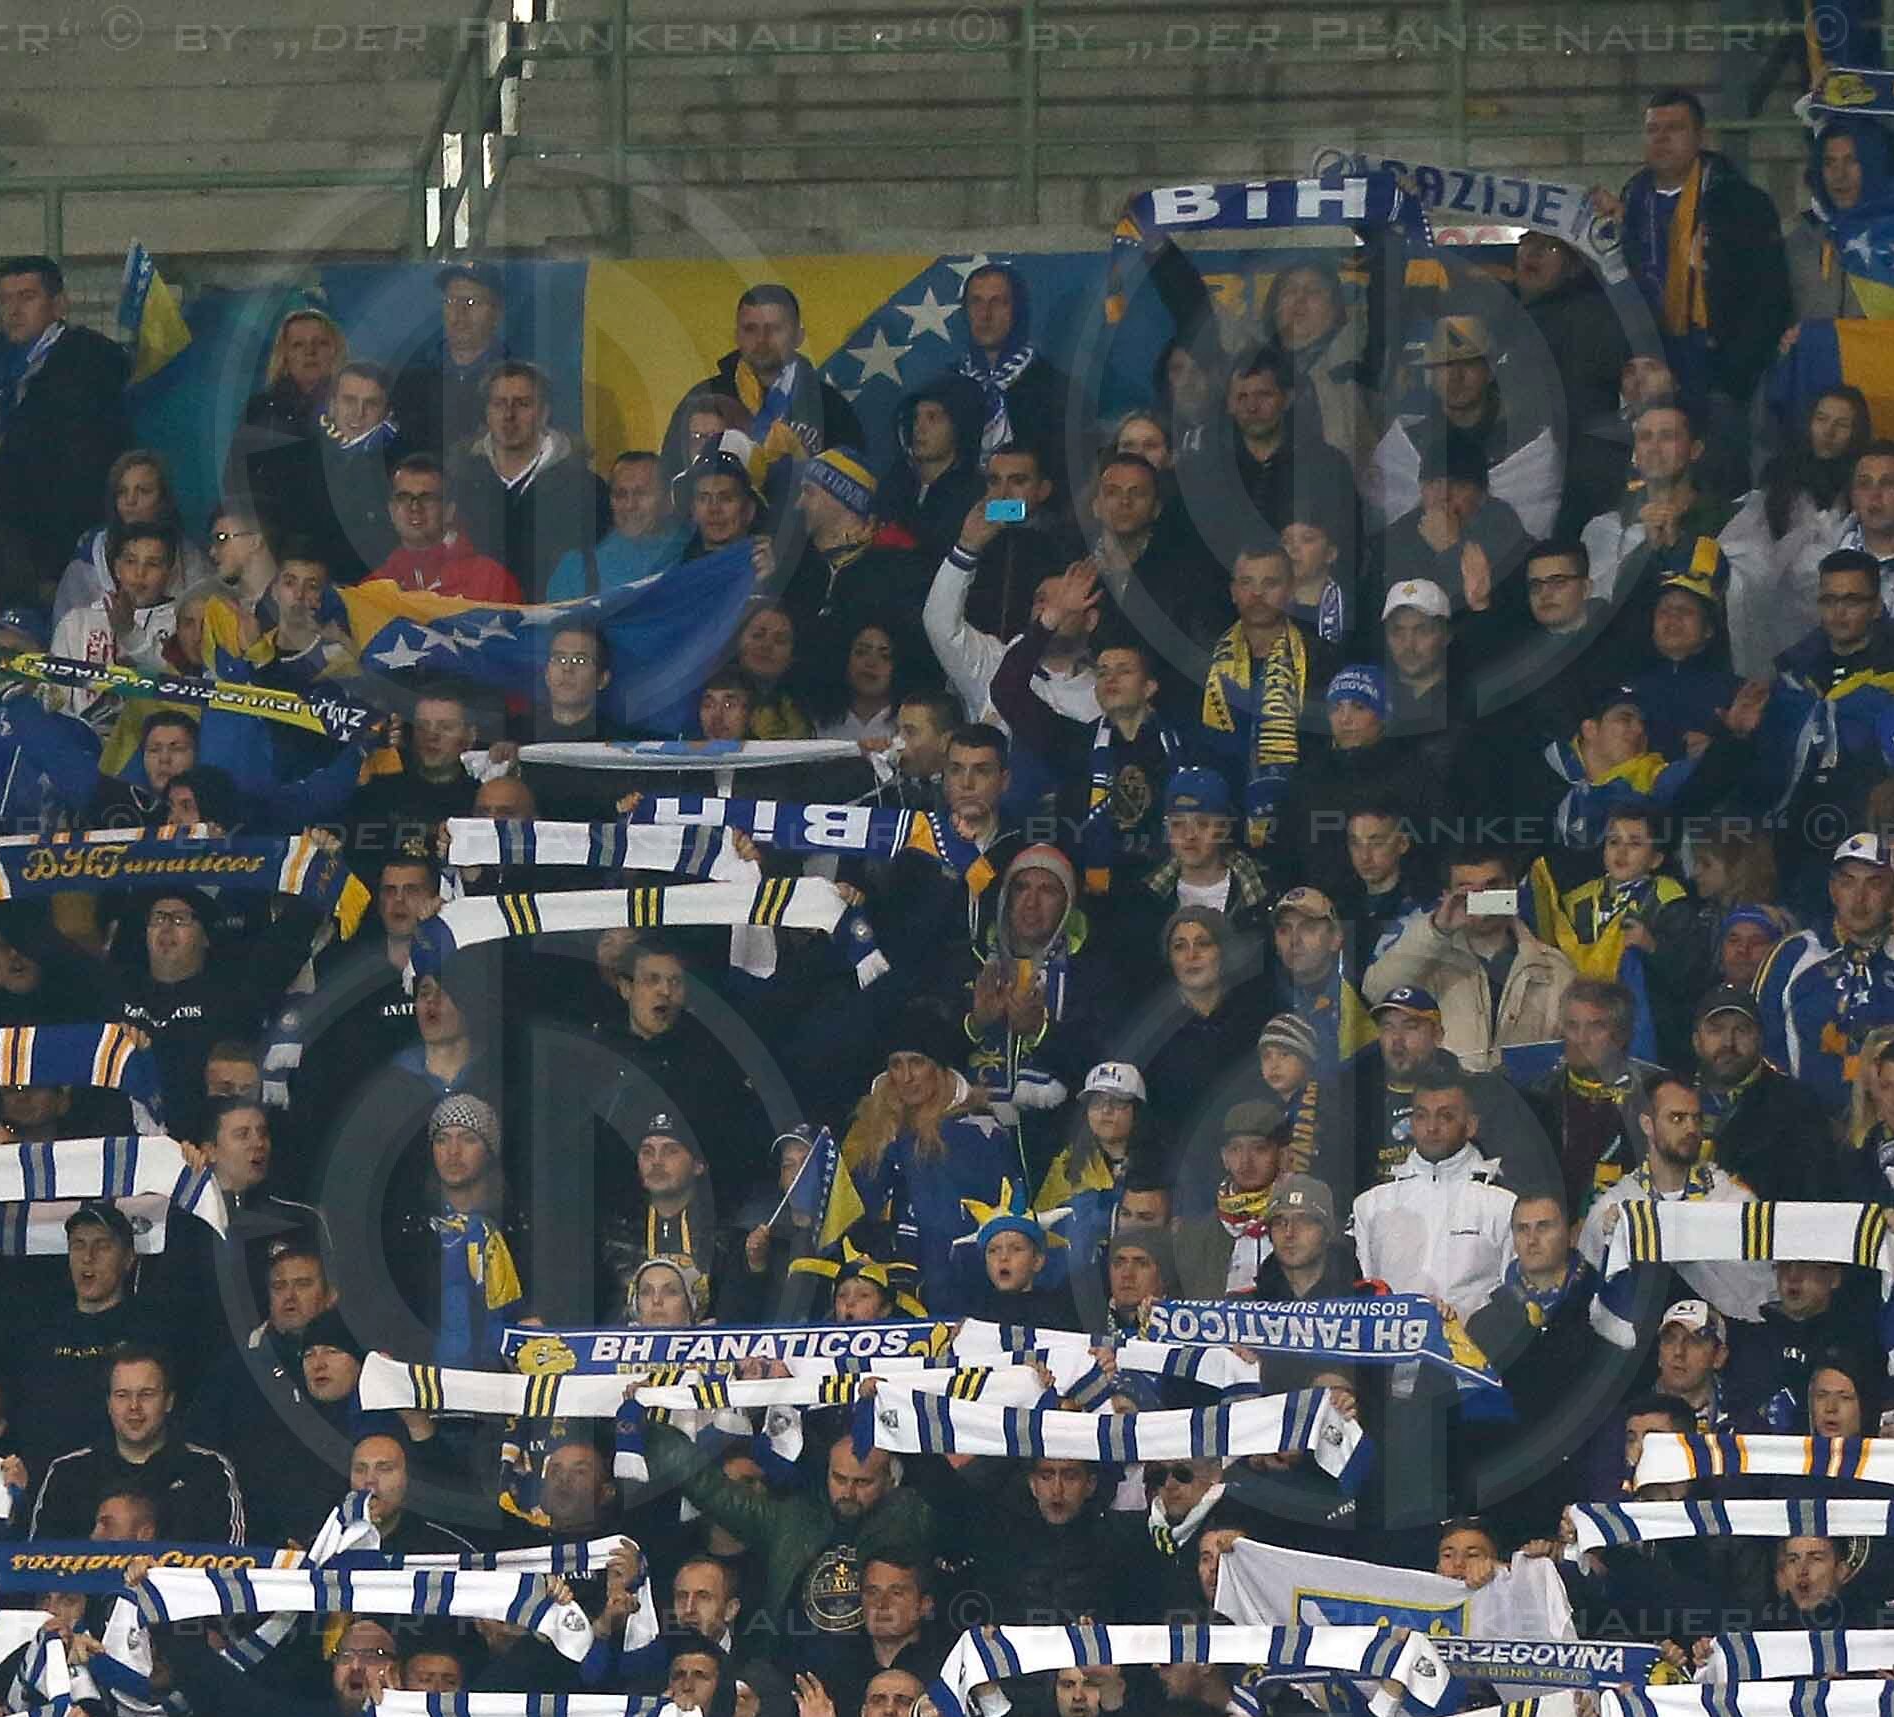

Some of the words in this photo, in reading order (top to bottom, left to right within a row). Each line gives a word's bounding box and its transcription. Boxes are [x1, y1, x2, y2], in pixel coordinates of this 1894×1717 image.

[1324, 1300, 1410, 1317] BOSNIAN
[591, 1336, 655, 1361] BH
[660, 1328, 911, 1362] FANATICOS
[1154, 1304, 1361, 1350] FANATICOS
[1371, 1314, 1430, 1350] BH
[1436, 1640, 1626, 1676] ERZEGOVINA
